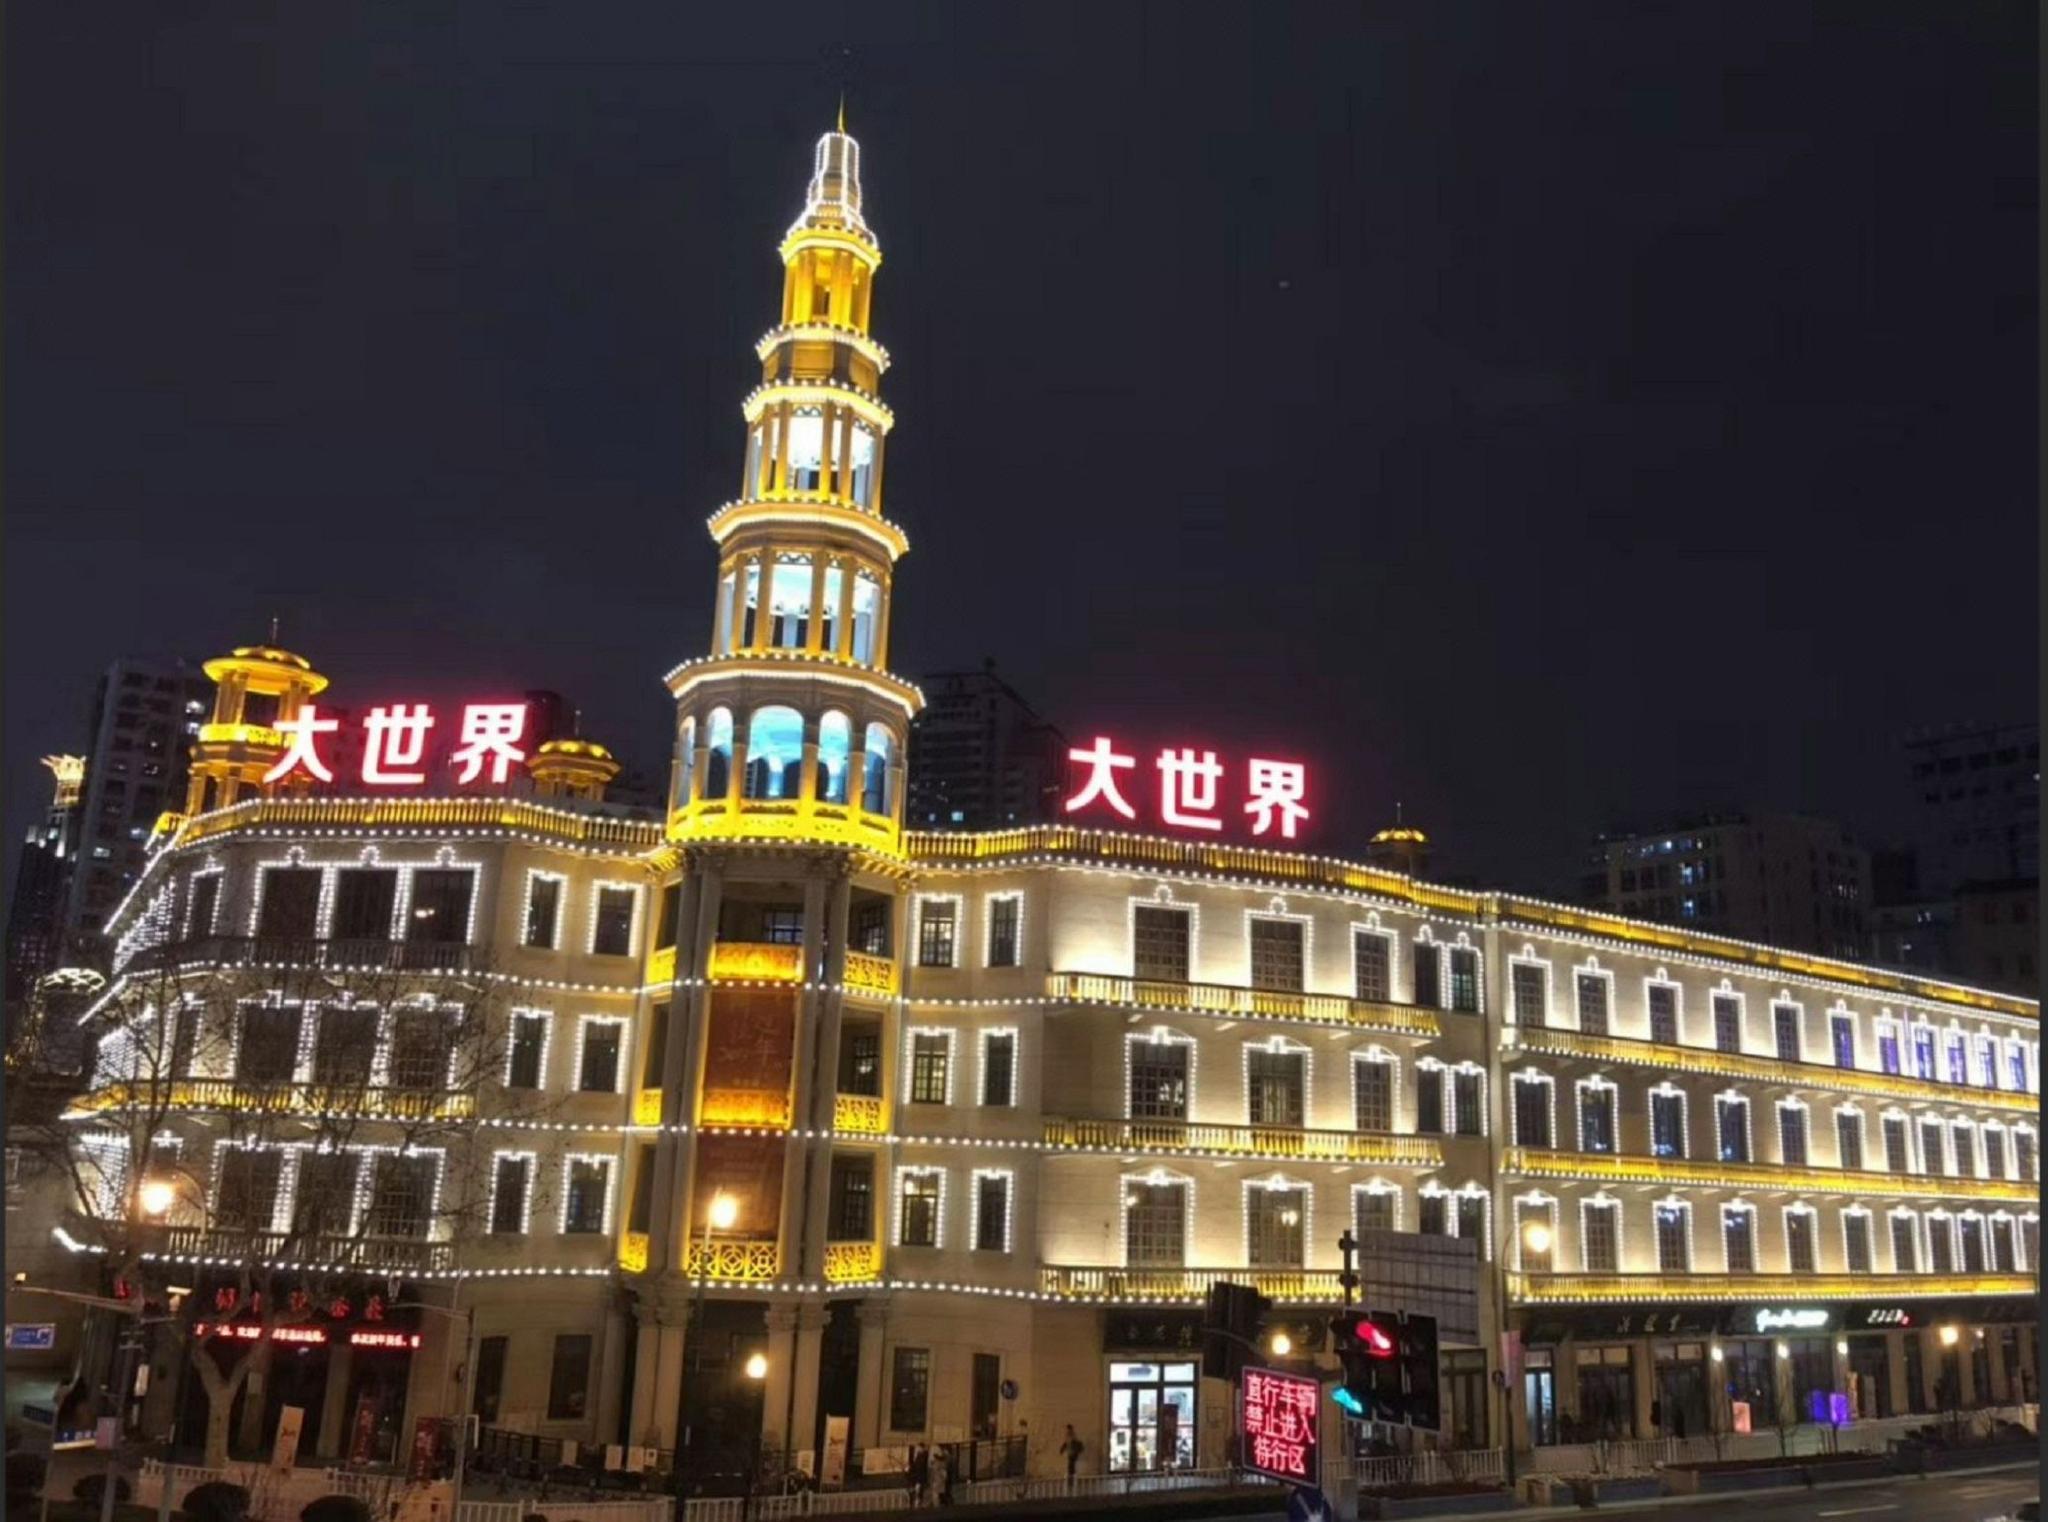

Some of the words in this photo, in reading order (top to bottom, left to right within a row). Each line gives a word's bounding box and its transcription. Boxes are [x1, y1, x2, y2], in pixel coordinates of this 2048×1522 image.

[262, 704, 527, 784] 大世界
[1065, 736, 1310, 839] 大世界
[1246, 1374, 1316, 1416] 直行车辆
[1246, 1404, 1315, 1444] 禁止进入
[1253, 1434, 1305, 1474] 待行区
